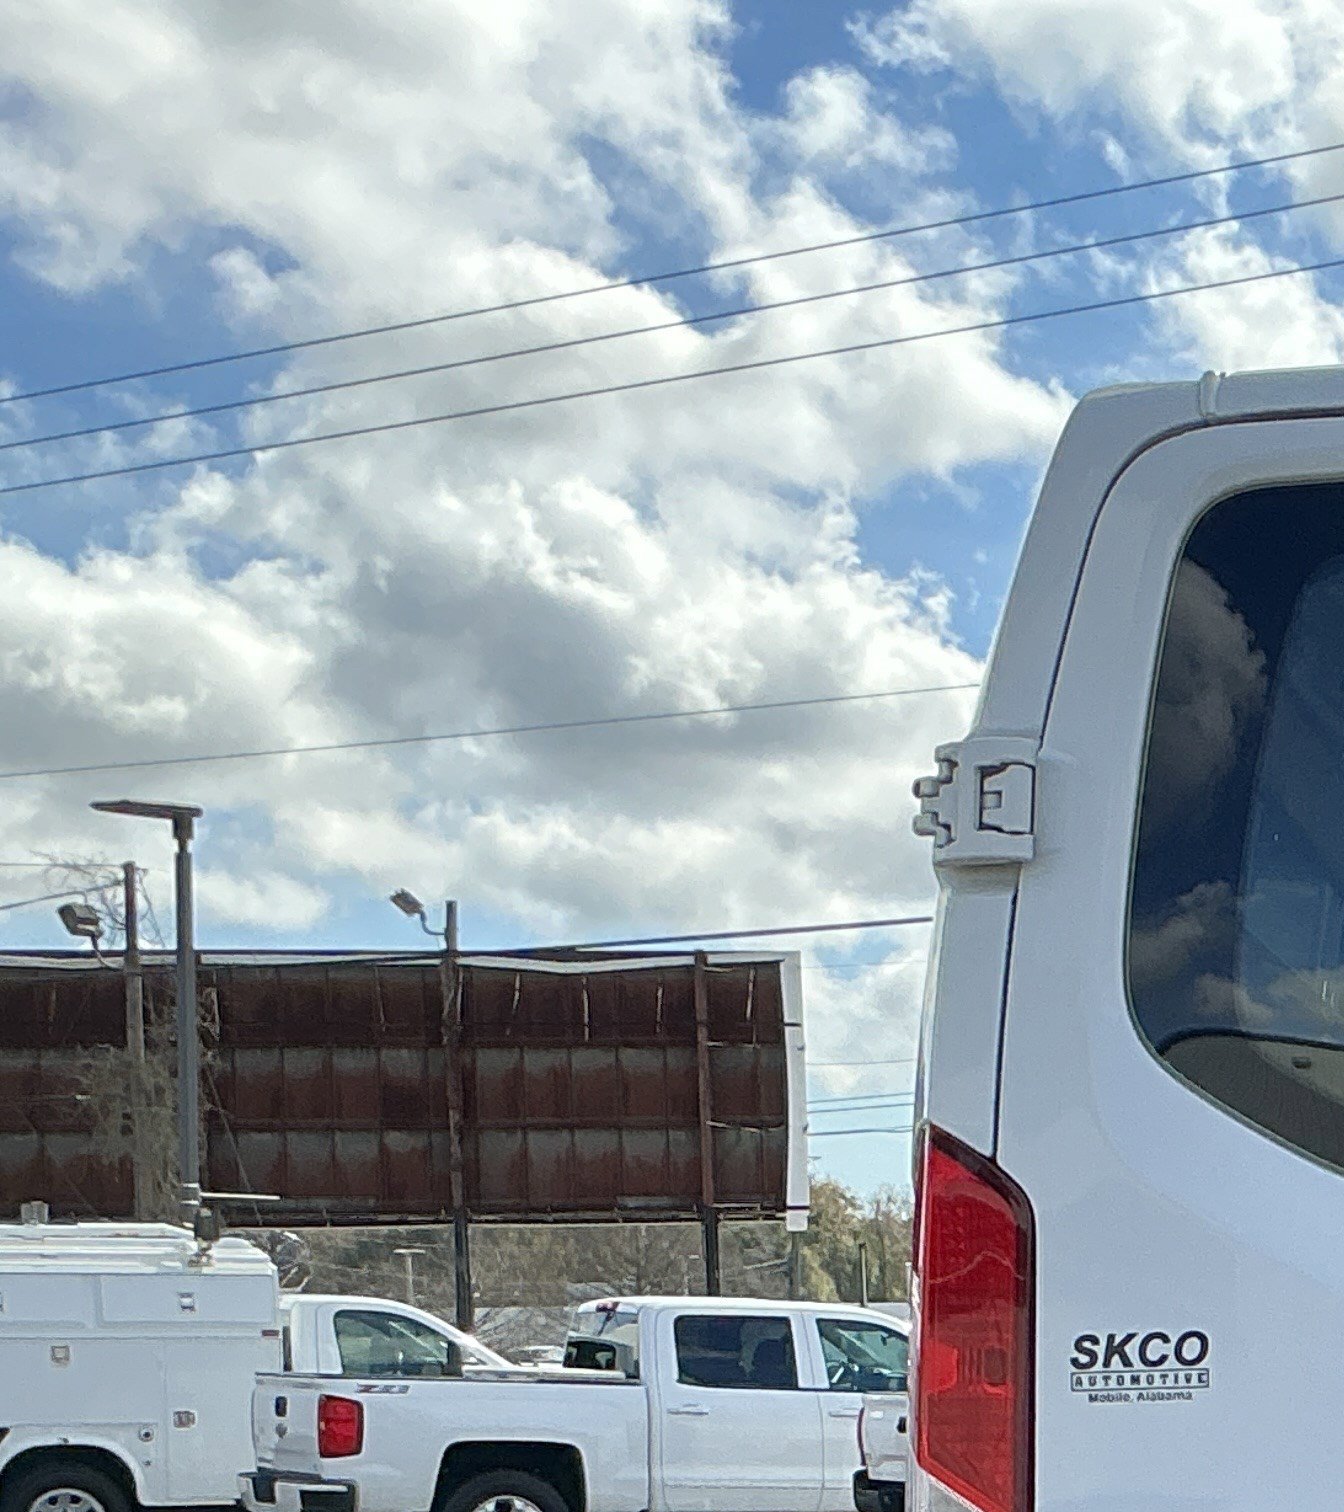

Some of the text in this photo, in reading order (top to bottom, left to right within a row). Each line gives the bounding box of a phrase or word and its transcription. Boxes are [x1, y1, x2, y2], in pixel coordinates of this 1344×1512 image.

[1069, 1330, 1209, 1370] SKCO
[1073, 1372, 1209, 1388] AUTOMOTIVE
[1136, 1390, 1194, 1402] Alabama
